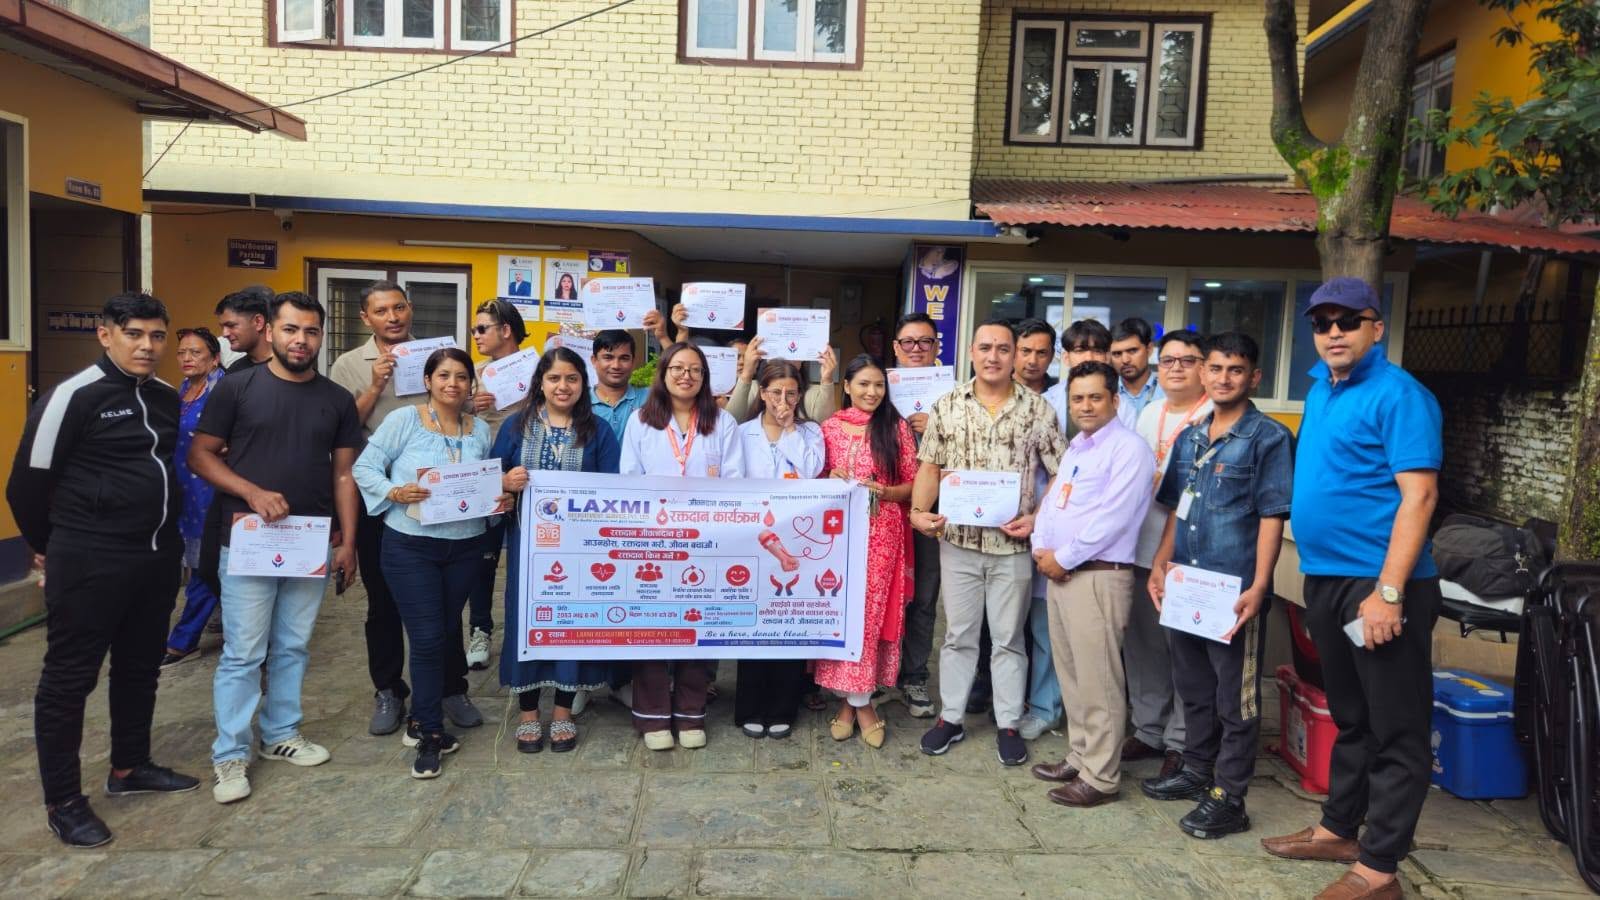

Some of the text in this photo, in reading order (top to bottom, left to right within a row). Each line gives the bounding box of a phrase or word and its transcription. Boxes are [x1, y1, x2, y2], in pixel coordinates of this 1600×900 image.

[100, 409, 134, 419] KELME
[567, 498, 650, 514] LAXMI
[670, 508, 760, 524] रक्तदान कार्यक्रम
[610, 529, 637, 537] रक्तदान
[638, 528, 674, 537] जीवनदान
[622, 540, 649, 548] रक्तदान
[617, 551, 643, 559] रक्तदान
